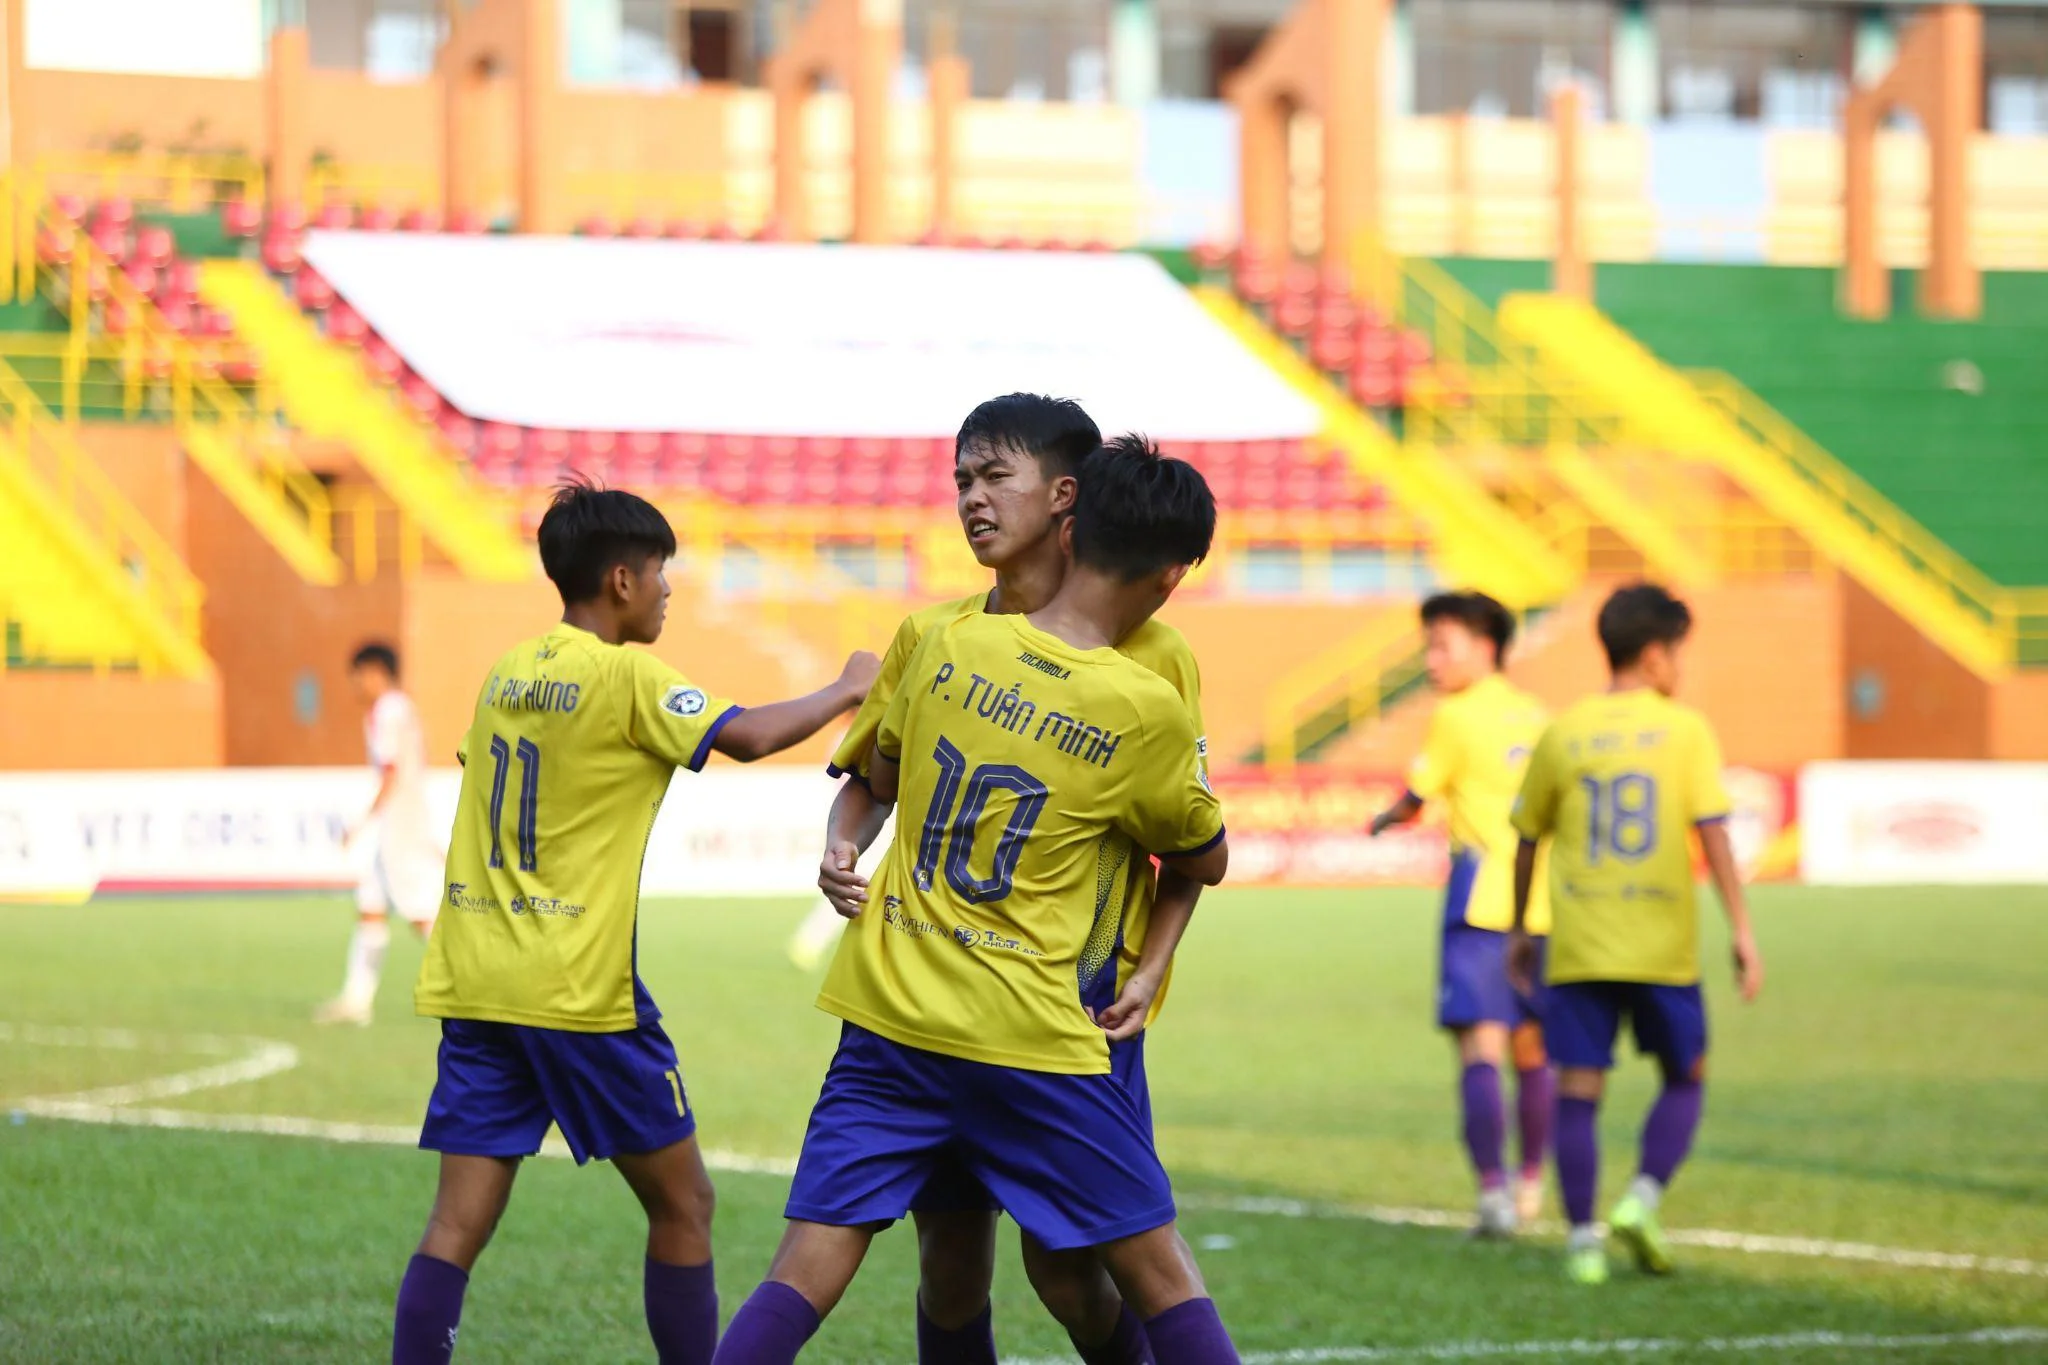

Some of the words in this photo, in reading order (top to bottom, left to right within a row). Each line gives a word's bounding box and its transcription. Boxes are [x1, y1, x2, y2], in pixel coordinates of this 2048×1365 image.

[525, 673, 580, 713] HÙNG
[930, 662, 955, 702] P.
[962, 672, 1037, 736] TUẤN
[1034, 711, 1122, 769] MINH
[488, 733, 541, 874] 11
[913, 734, 1050, 906] 10
[1581, 770, 1657, 867] 18
